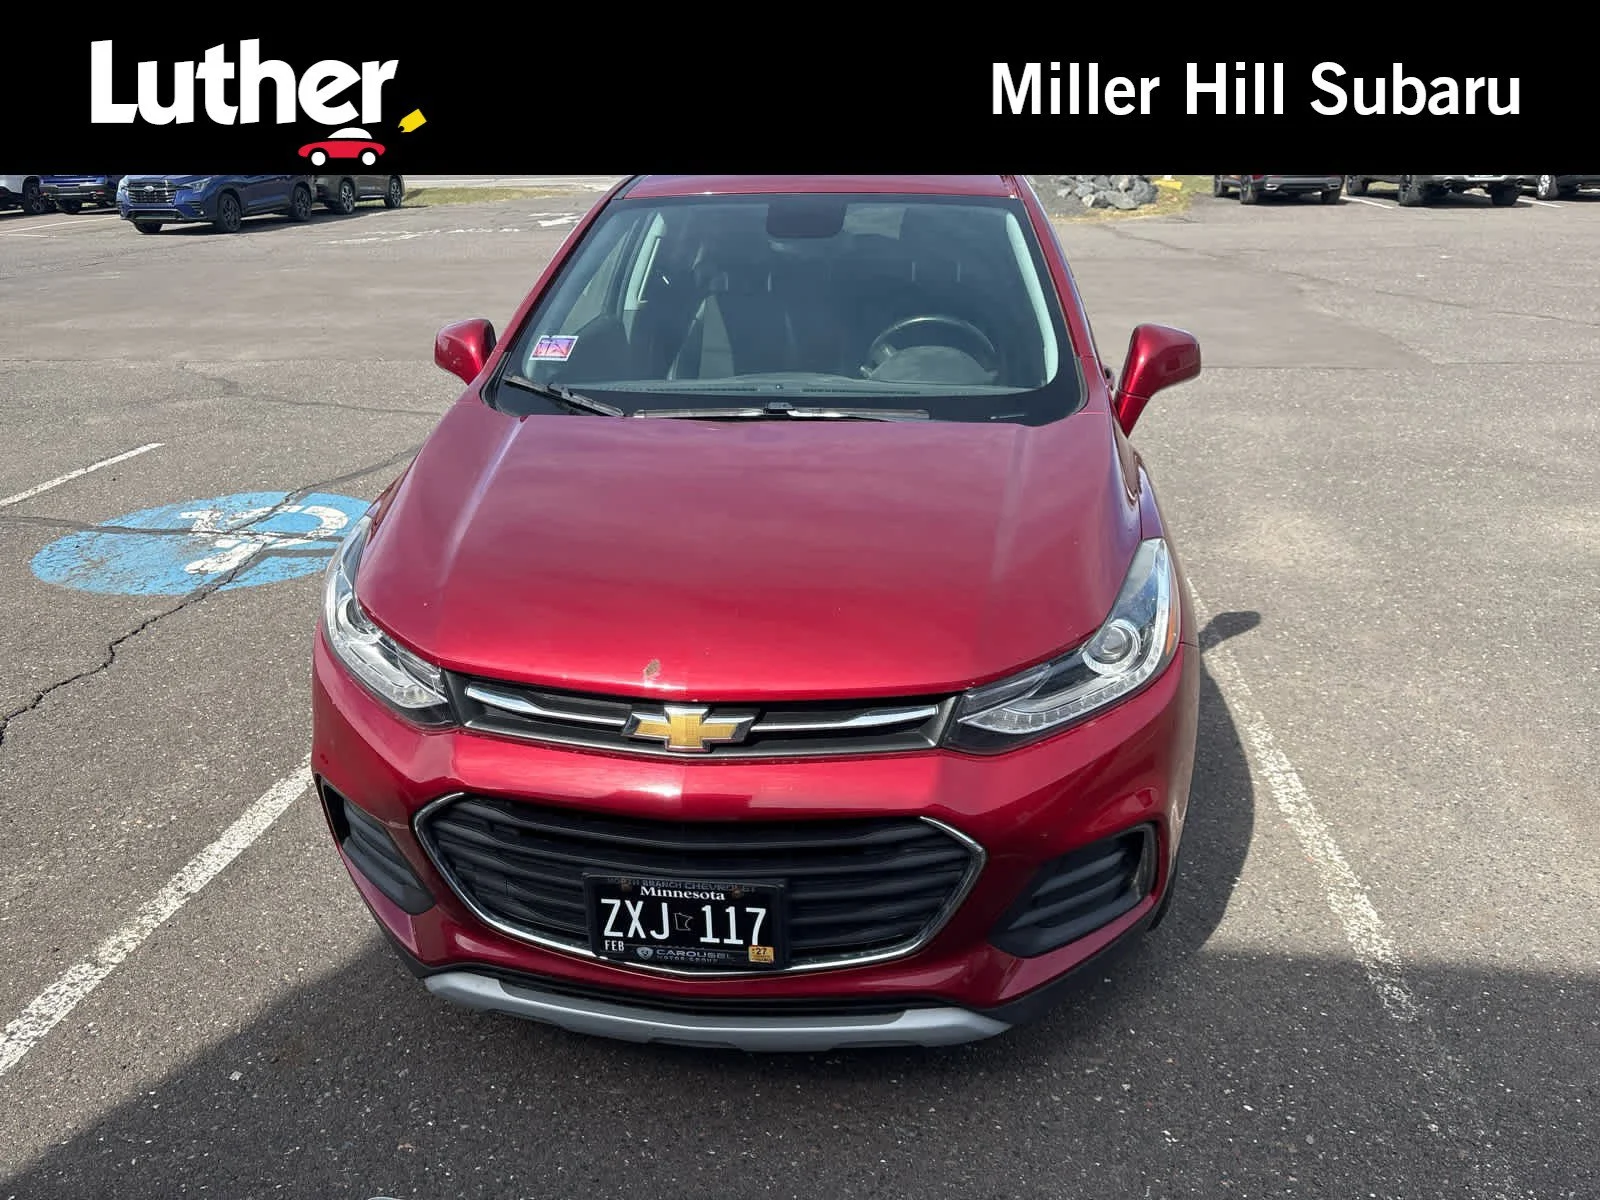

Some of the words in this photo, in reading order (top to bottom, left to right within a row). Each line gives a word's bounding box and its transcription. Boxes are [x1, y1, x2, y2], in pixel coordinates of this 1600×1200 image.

[640, 886, 726, 901] Minnesota
[601, 898, 670, 940] ZXJ
[700, 904, 767, 946] 117
[604, 940, 625, 952] FEB
[656, 949, 730, 959] CAROUSEL
